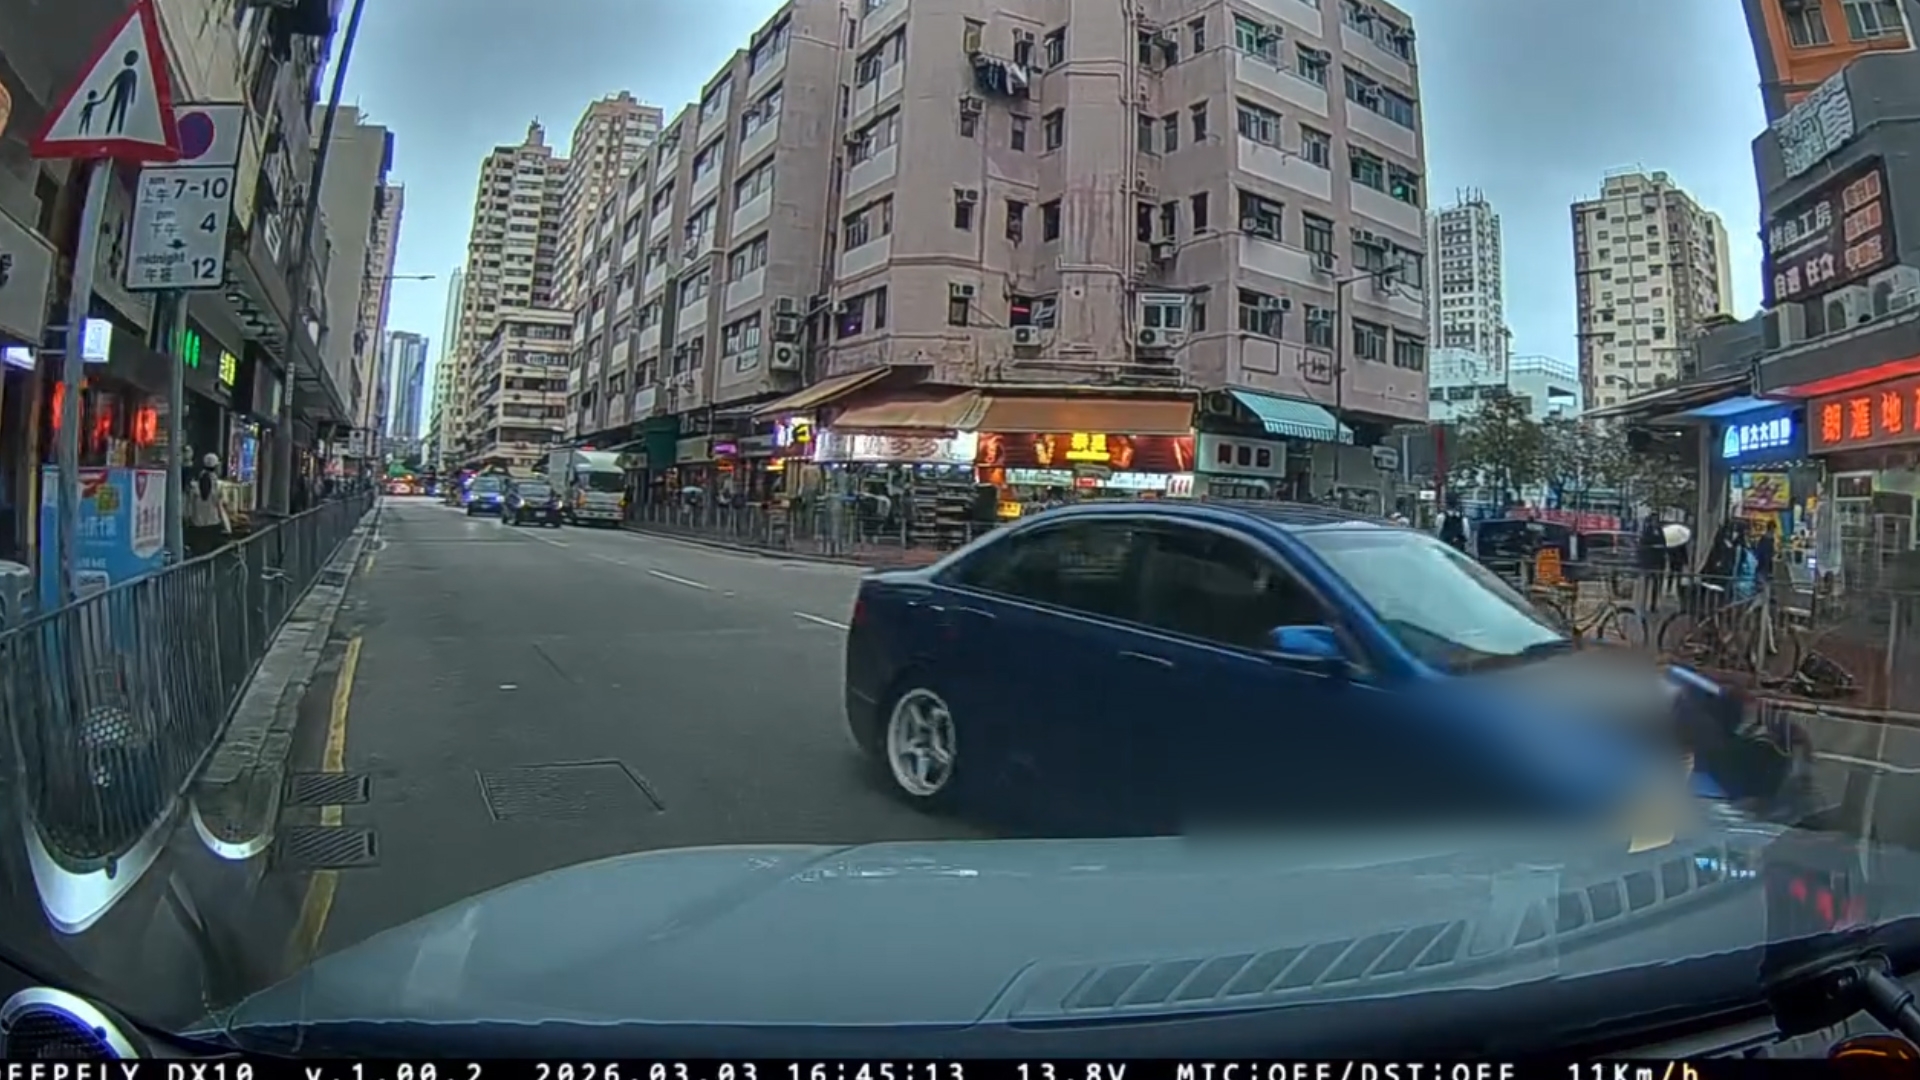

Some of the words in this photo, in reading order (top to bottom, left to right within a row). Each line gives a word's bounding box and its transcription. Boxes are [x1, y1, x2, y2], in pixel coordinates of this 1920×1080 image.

[142, 187, 171, 204] 上午
[173, 177, 229, 200] 7-10
[150, 222, 179, 239] 下午
[199, 211, 217, 234] 4
[137, 251, 186, 267] midnight
[191, 256, 217, 280] 12
[1821, 387, 1920, 443] 朗滙地
